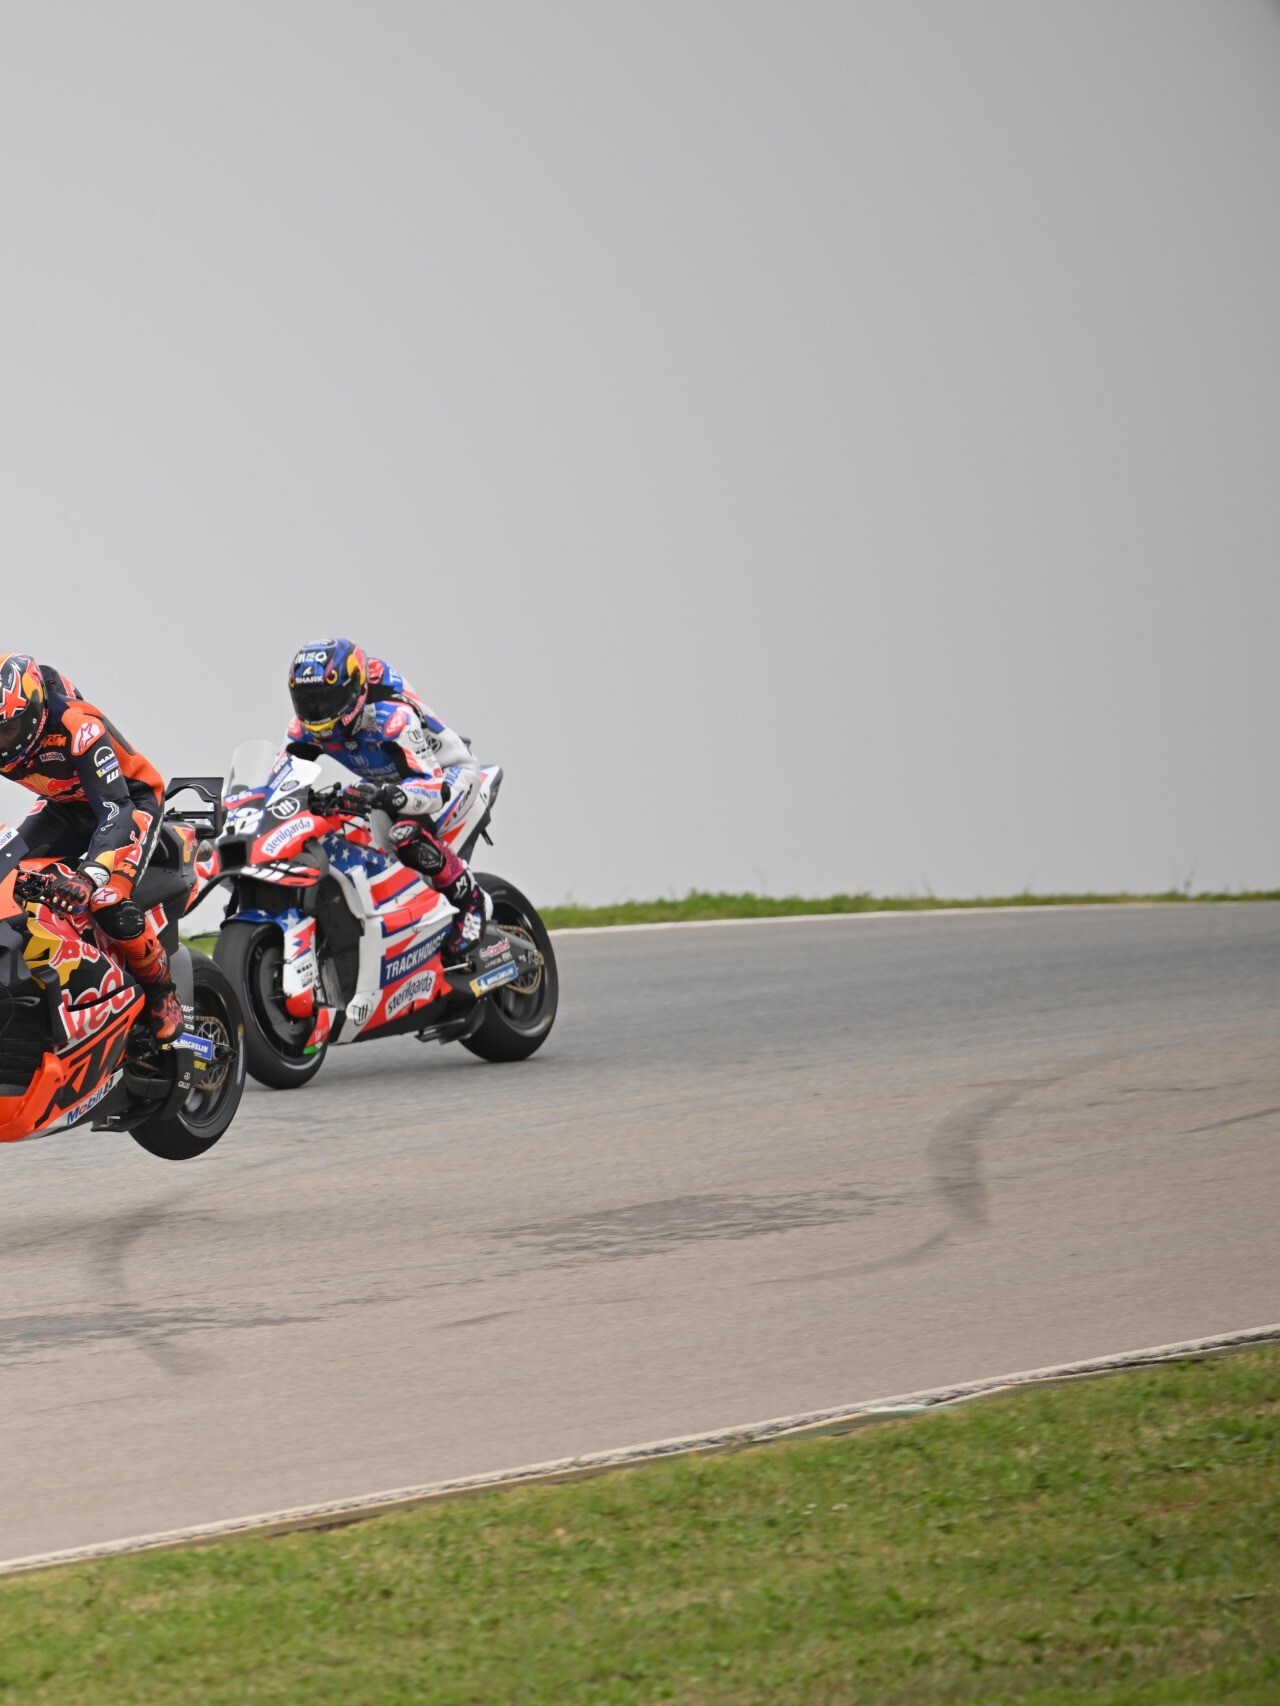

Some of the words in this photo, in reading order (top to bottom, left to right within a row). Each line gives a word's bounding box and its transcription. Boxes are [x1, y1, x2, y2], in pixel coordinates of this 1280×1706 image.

[295, 675, 324, 684] SHARK
[265, 818, 311, 854] sterilgarda
[387, 971, 434, 1015] sterilgarda
[34, 1014, 131, 1130] KTM
